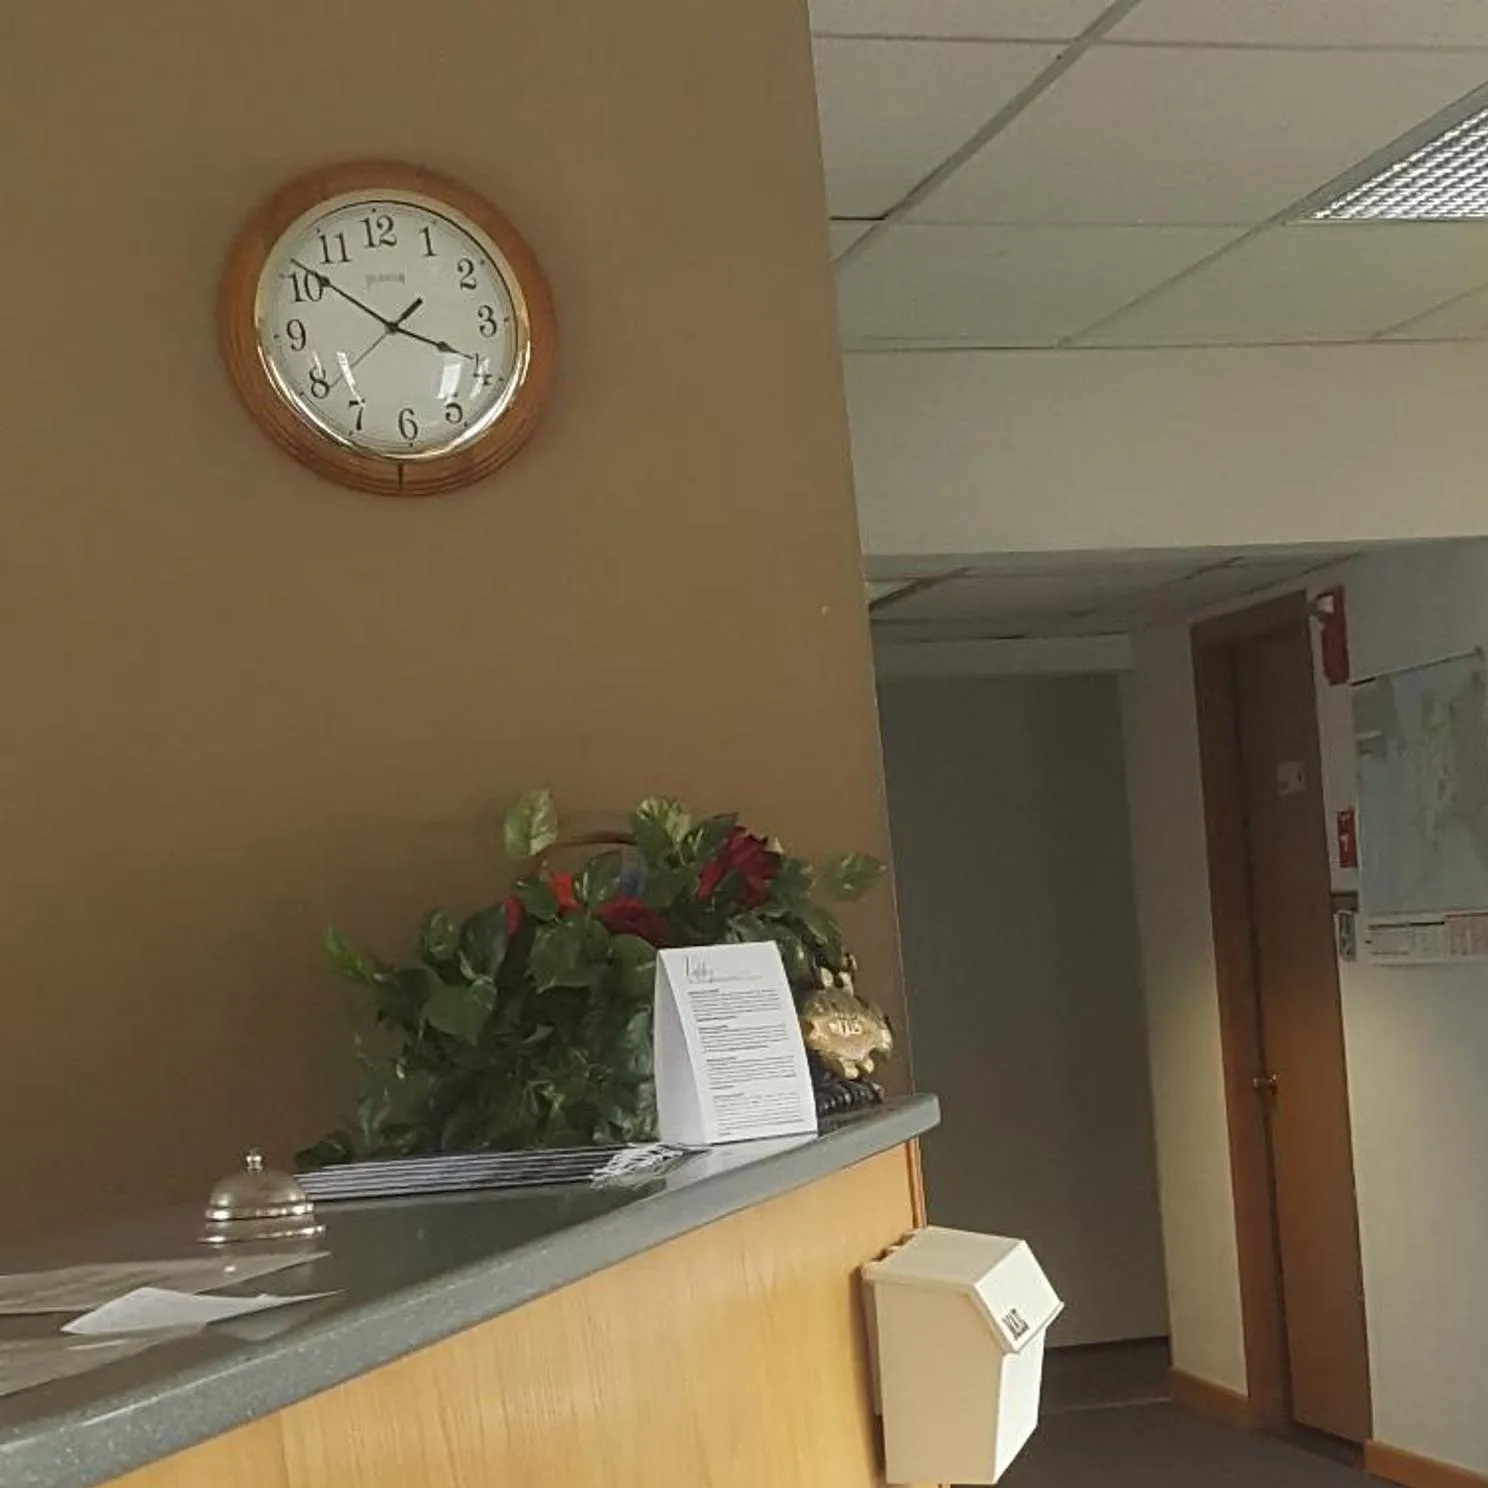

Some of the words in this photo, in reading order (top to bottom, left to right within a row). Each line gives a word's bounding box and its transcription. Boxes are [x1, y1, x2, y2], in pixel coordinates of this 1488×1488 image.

[317, 231, 351, 265] 11
[360, 215, 398, 249] 12
[419, 226, 438, 258] 1
[288, 271, 326, 303] 10
[457, 258, 477, 291] 2
[286, 318, 307, 352] 9
[477, 304, 498, 338] 3
[309, 366, 331, 399] 8
[471, 352, 493, 386] 4
[347, 398, 366, 431] 7
[398, 407, 419, 441] 6
[444, 393, 464, 425] 5
